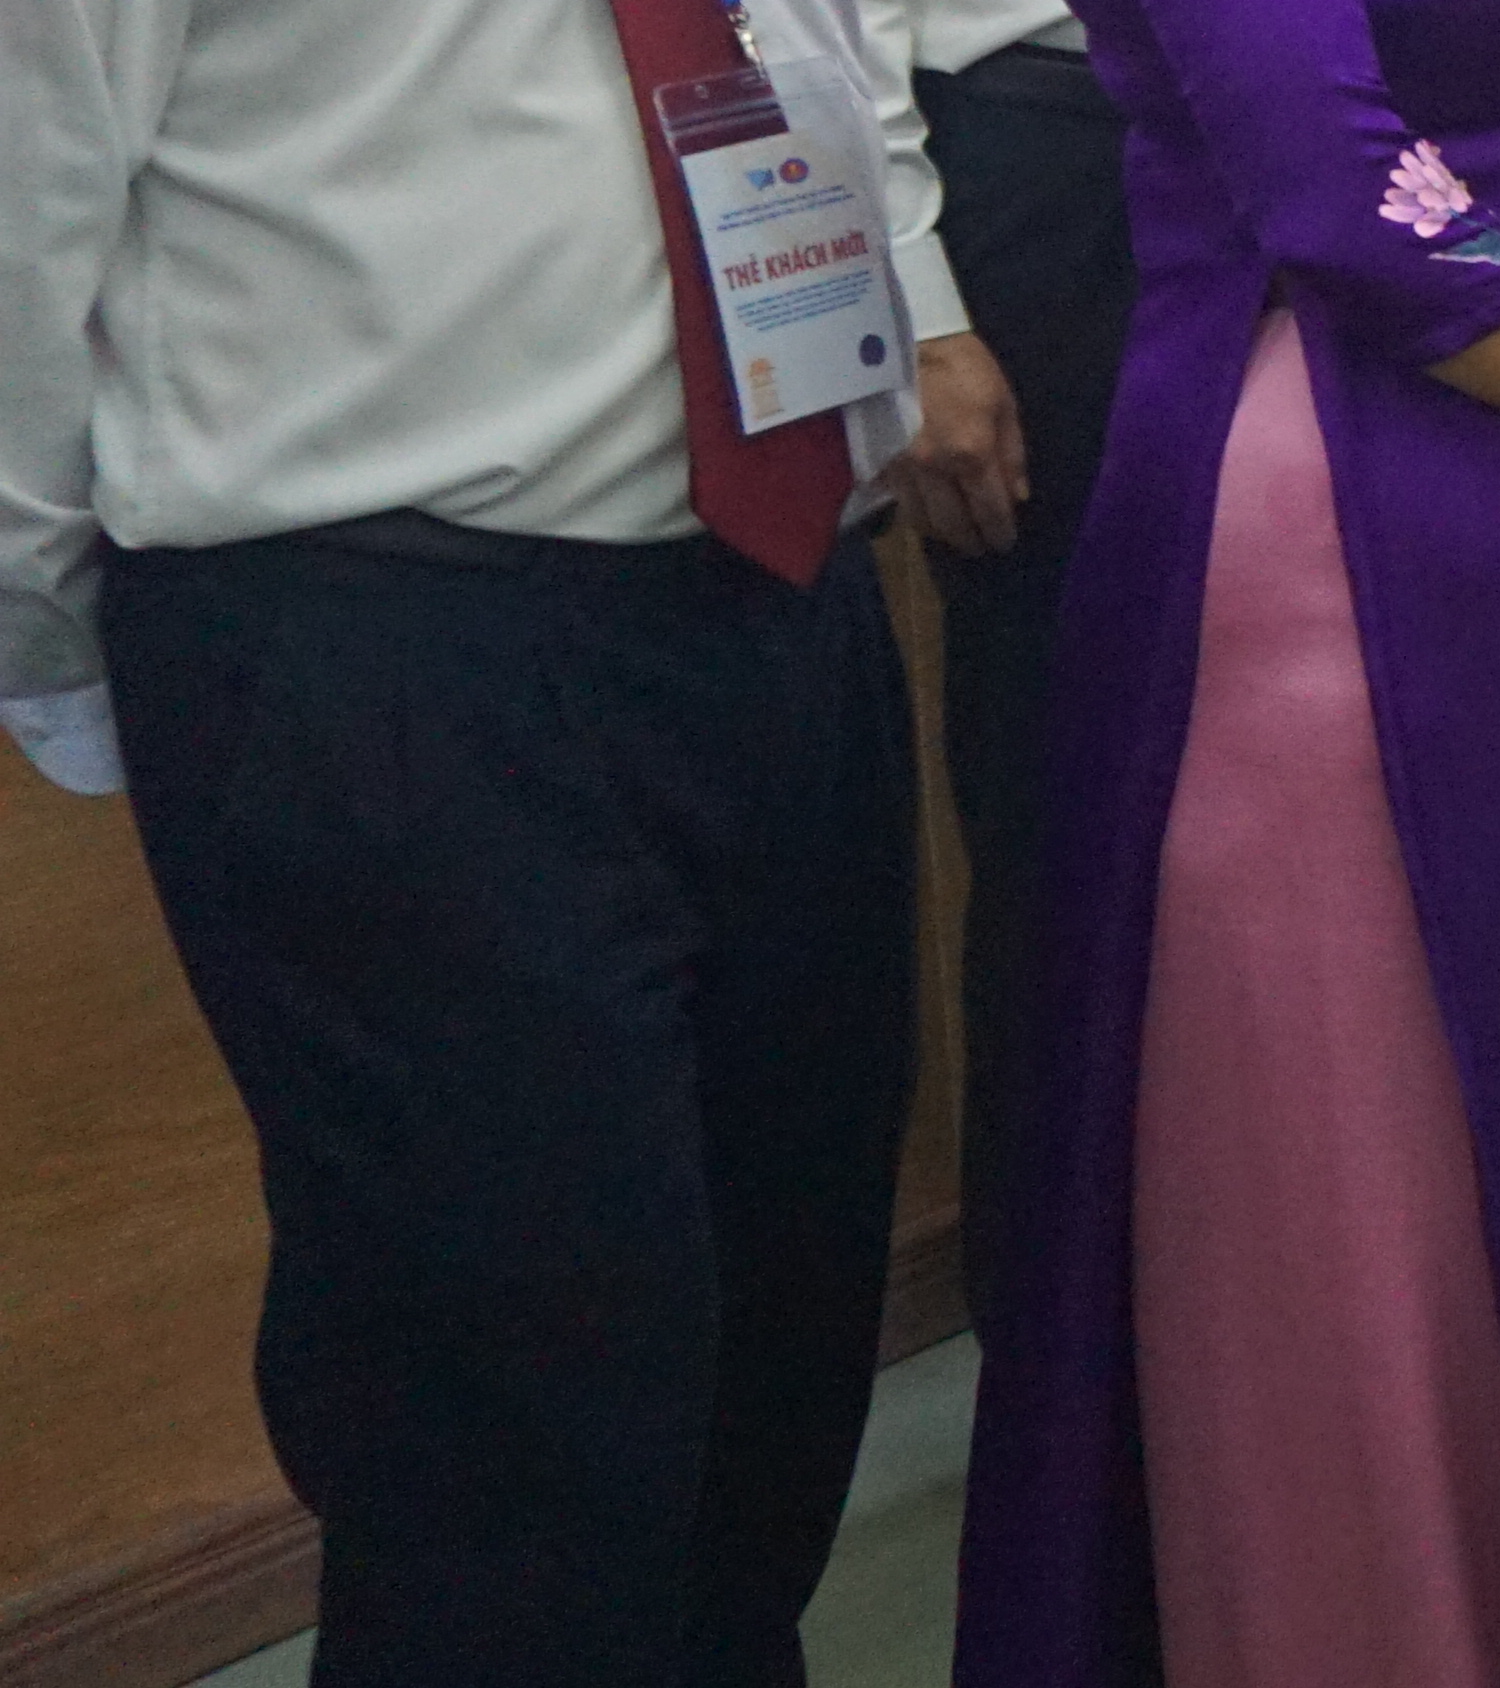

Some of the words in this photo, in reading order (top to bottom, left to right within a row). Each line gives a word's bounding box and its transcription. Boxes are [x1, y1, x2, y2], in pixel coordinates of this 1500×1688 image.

[722, 253, 763, 291] THẺ
[764, 243, 829, 281] KHÁCH
[830, 229, 869, 262] MỜI
